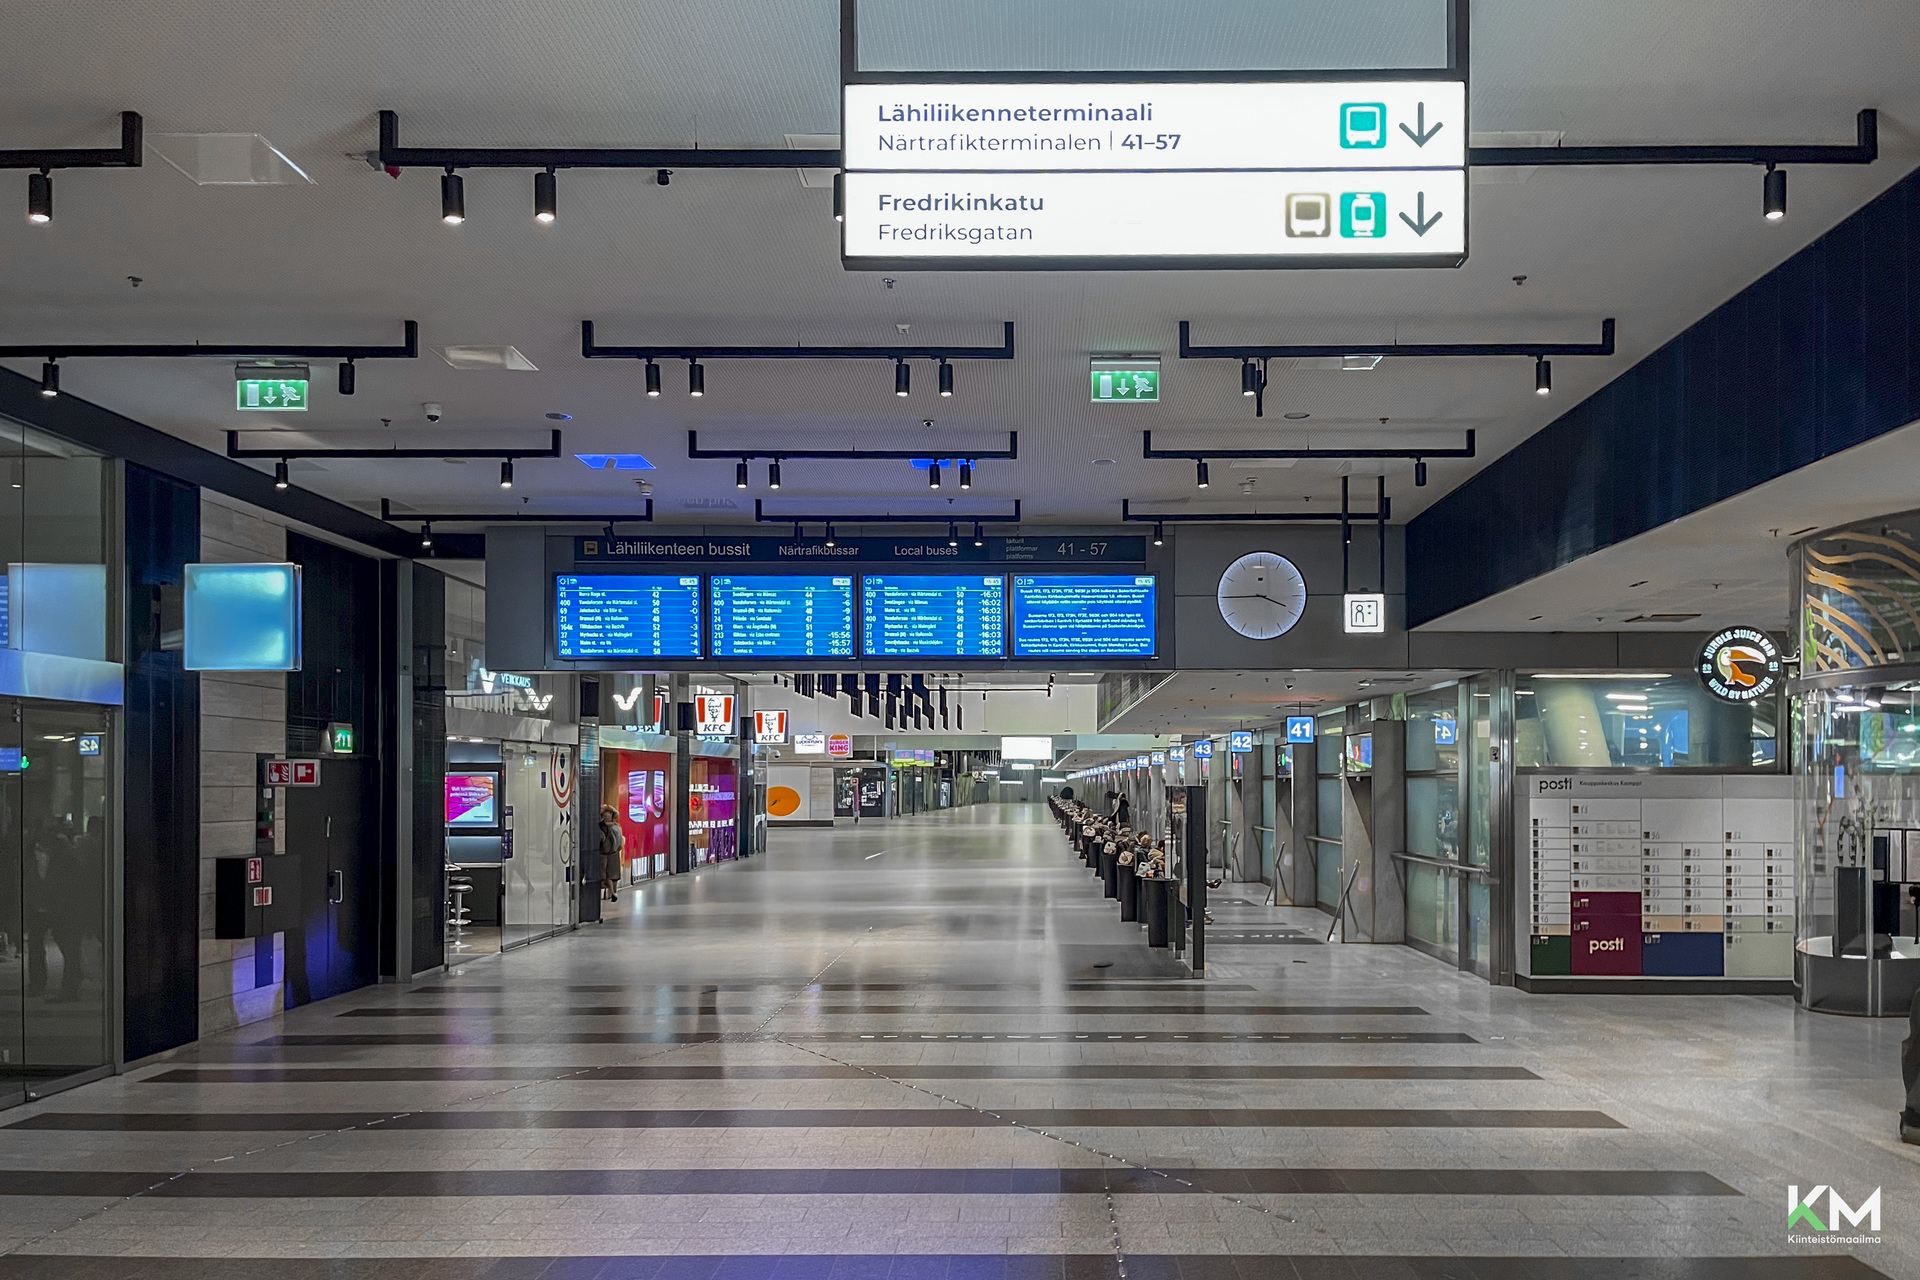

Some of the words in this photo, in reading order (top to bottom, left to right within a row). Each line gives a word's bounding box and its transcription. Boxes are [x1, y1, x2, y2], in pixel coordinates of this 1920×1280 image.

[878, 103, 1153, 123] Lähiliikenneterminaali
[878, 133, 1101, 152] Närtrafikterminalen
[878, 193, 1044, 213] Fredrikinkatu
[878, 223, 1033, 245] Fredriksgatan
[607, 542, 705, 555] Lähiliikenteen
[709, 542, 751, 555] bussit
[779, 544, 859, 556] Närtrafikbussar
[894, 545, 924, 556] Local
[926, 545, 958, 556] buses
[1057, 542, 1073, 555] 41
[1089, 542, 1108, 555] 57
[1733, 629, 1763, 643] JUICE
[500, 673, 531, 688] VEIKKAUS
[1708, 678, 1729, 697] WILD
[1728, 690, 1741, 699] BY
[1741, 676, 1774, 699] NATURE
[703, 723, 727, 733] KFC
[1291, 722, 1310, 738] 41
[761, 733, 781, 742] KFC
[1233, 736, 1251, 749] 42
[1171, 749, 1185, 758] 44
[1195, 744, 1211, 755] 43
[1138, 757, 1149, 765] 46
[1152, 753, 1165, 763] 45
[1539, 777, 1573, 793] posti
[1620, 780, 1643, 788] Kamppi
[1589, 937, 1624, 954] posti
